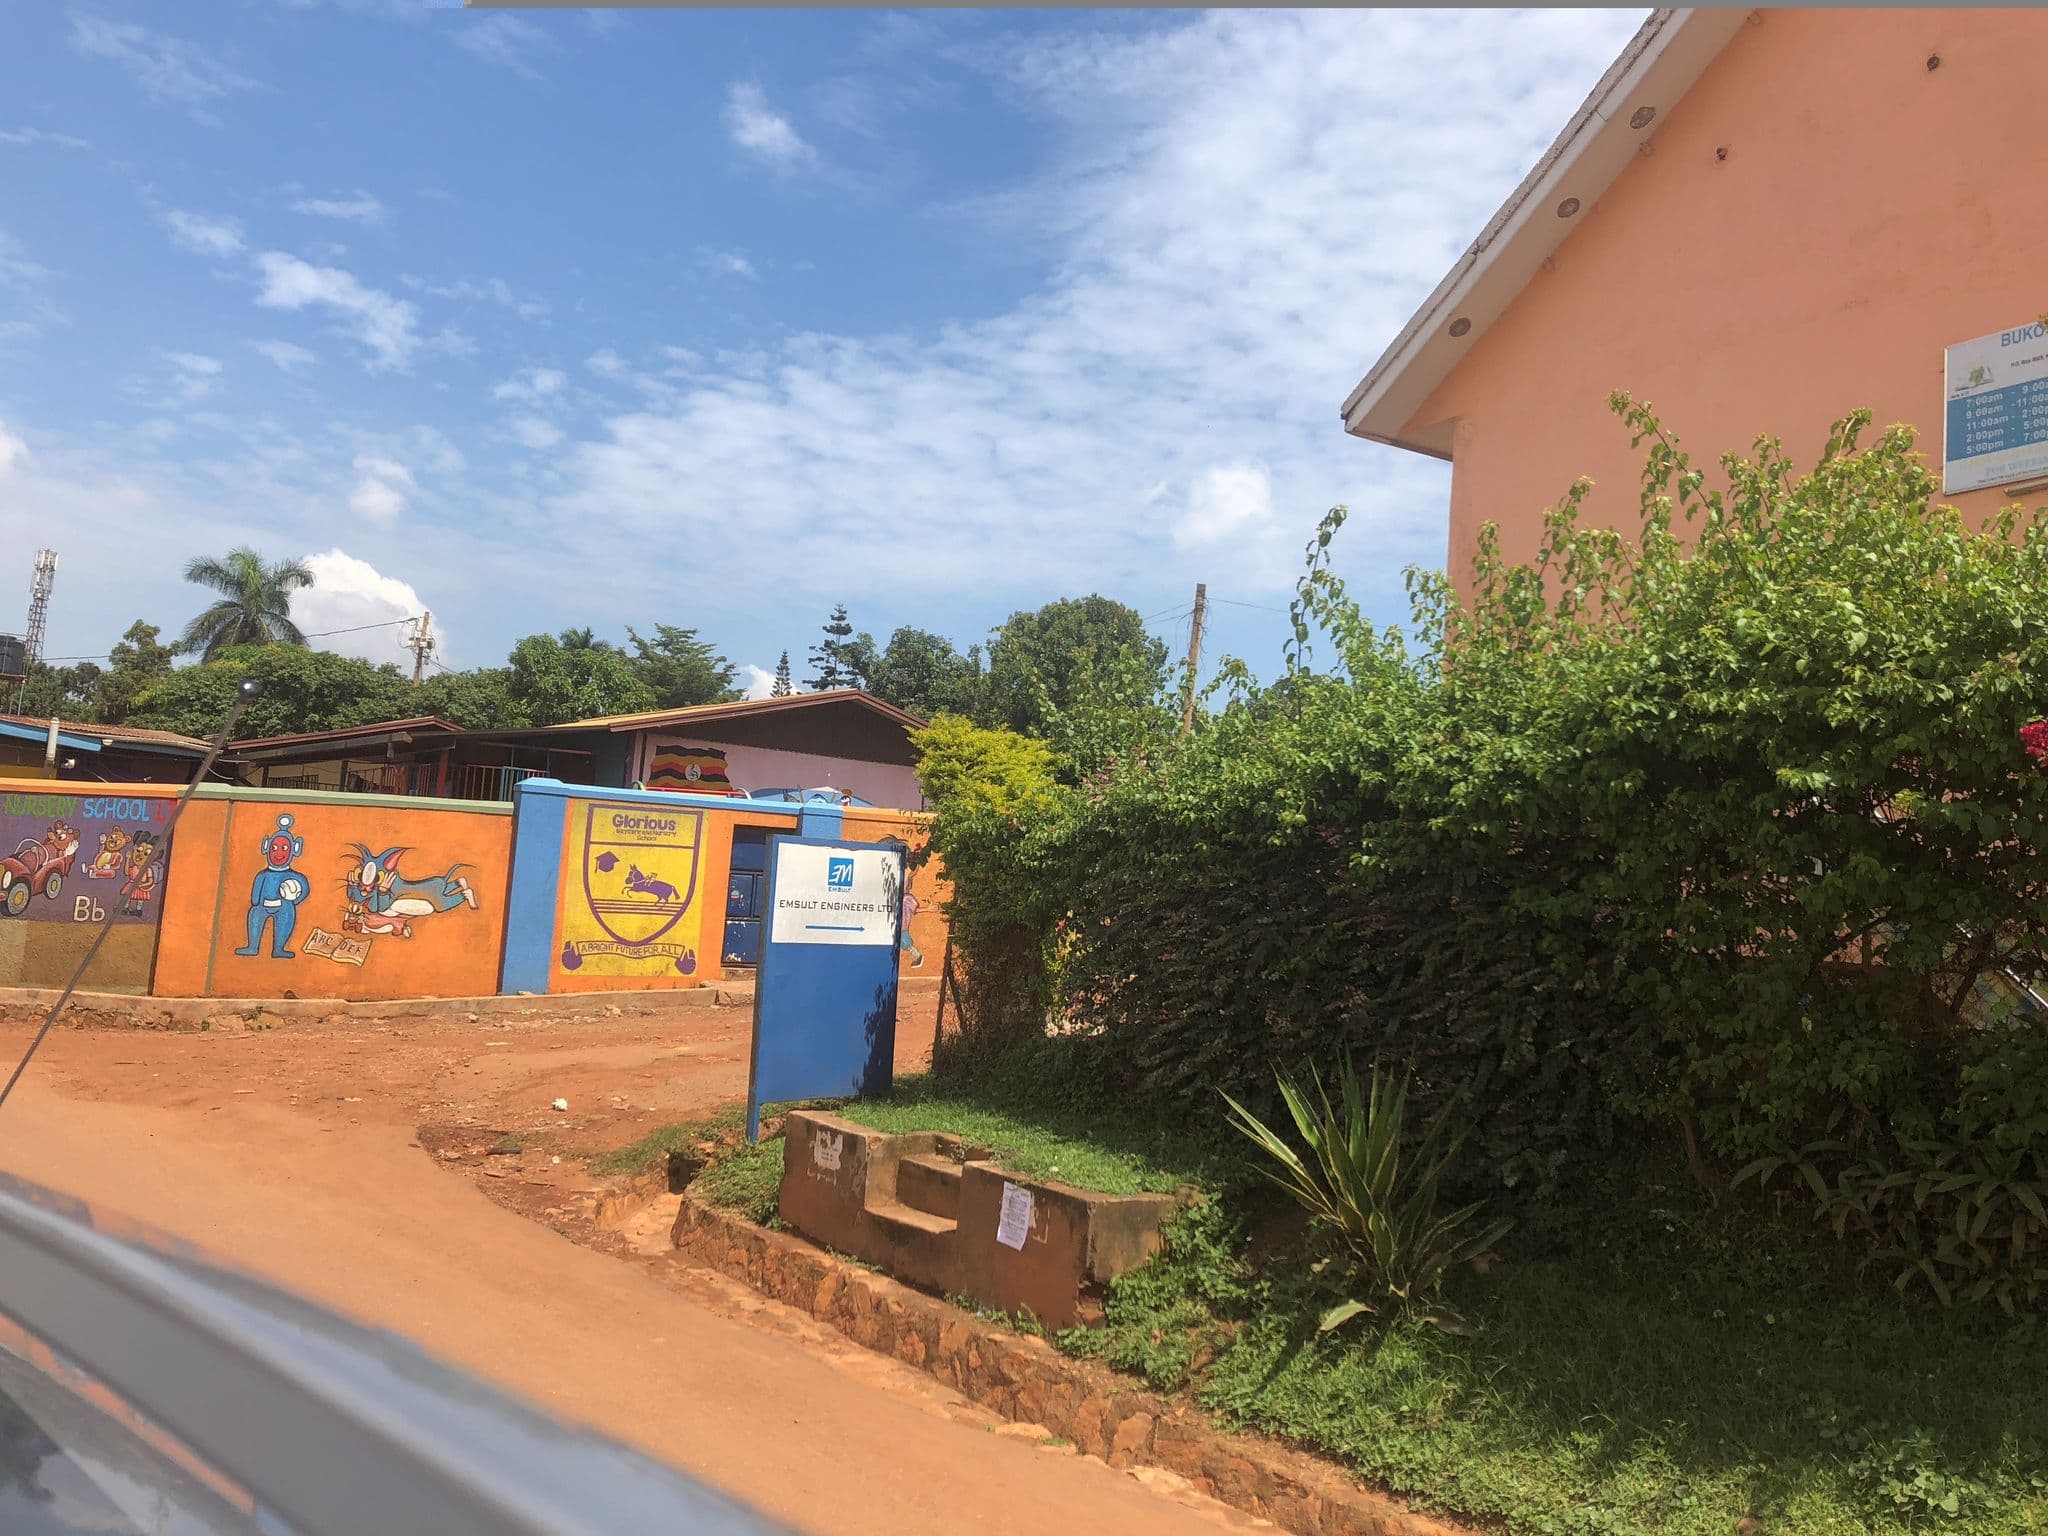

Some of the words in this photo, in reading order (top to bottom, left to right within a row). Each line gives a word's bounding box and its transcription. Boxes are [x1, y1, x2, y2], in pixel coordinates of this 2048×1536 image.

[1966, 393, 2003, 407] 7:00am
[1966, 405, 2003, 419] 9:00am
[1967, 415, 2009, 430] 11:00am
[1966, 428, 2004, 442] 2:00pm
[1966, 440, 2004, 454] 5:00pm
[4, 794, 76, 818] NURSERY
[83, 797, 150, 822] SCHOOL
[612, 813, 676, 831] Glorious
[73, 895, 106, 922] Bb
[779, 899, 818, 910] EMSULT
[820, 902, 874, 912] ENGINEERS
[877, 904, 893, 913] LTD
[581, 944, 588, 953] A
[588, 942, 614, 953] BRIGHT
[615, 944, 644, 957] FUTURE
[644, 946, 658, 956] FOR
[661, 946, 680, 956] ALL
